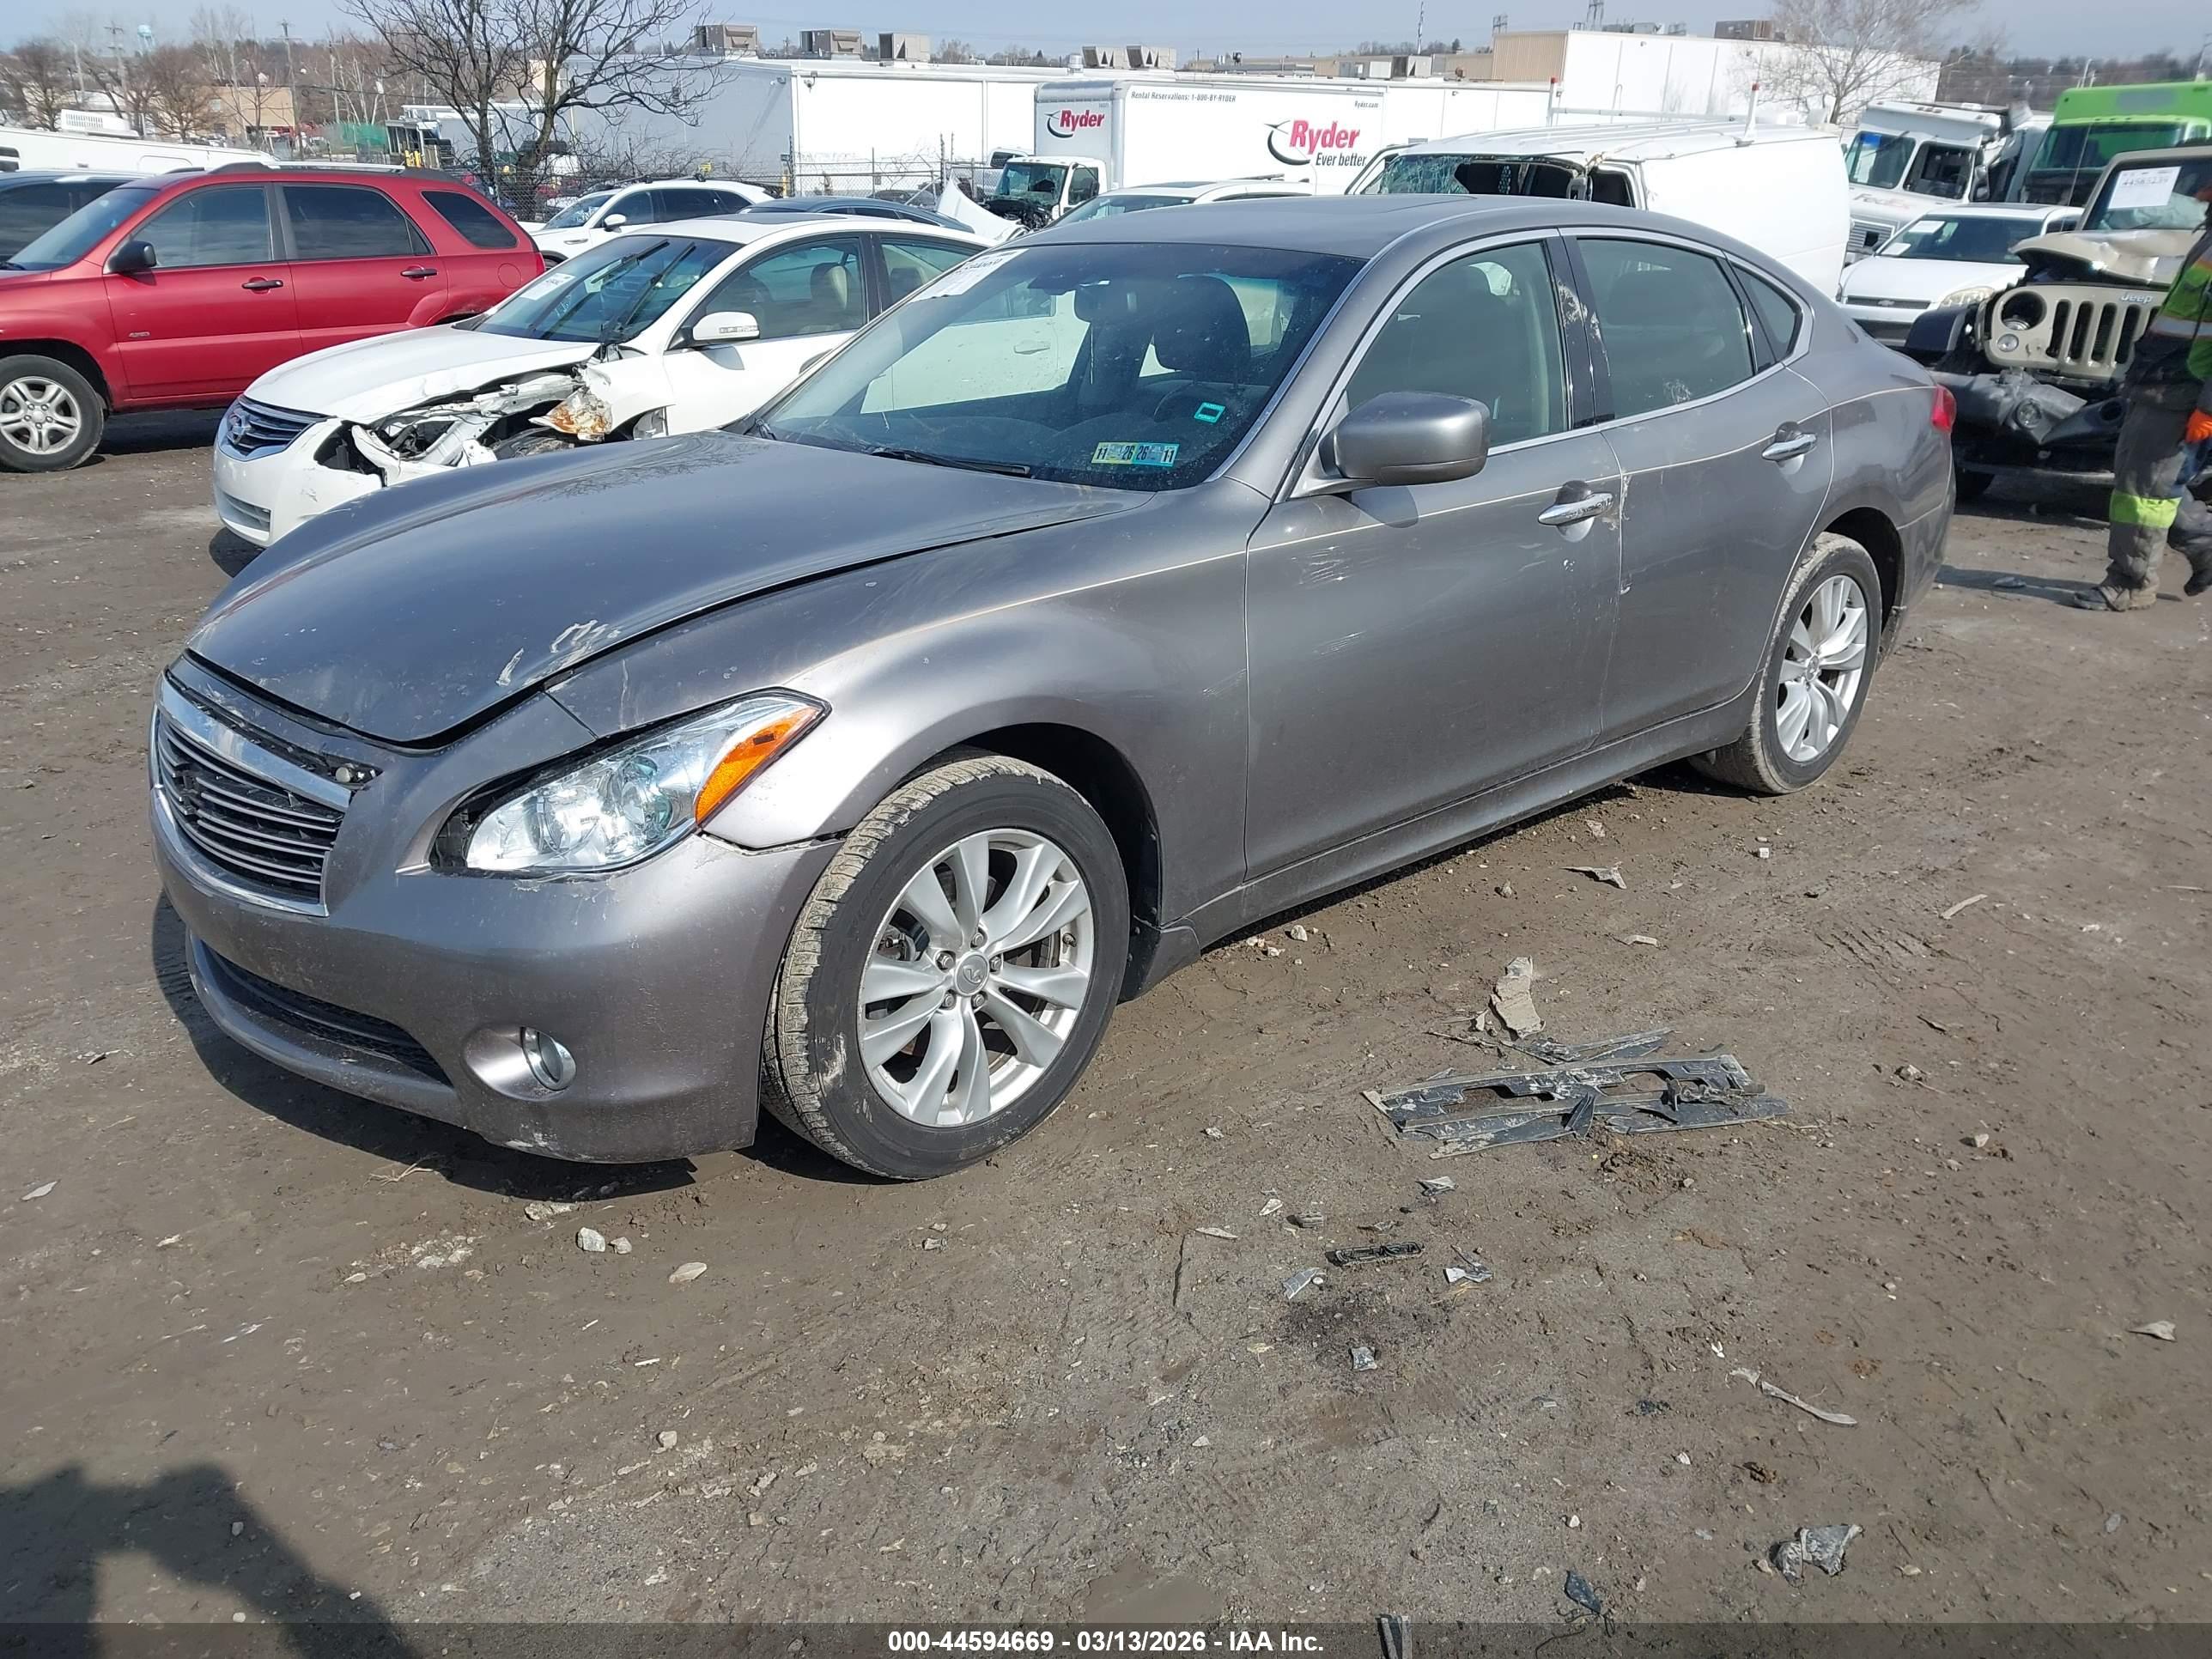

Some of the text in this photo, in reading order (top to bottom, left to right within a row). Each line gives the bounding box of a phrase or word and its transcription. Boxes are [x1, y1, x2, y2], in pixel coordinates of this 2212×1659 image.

[1131, 91, 1150, 100] Rental
[1151, 92, 1190, 101] Reservations:
[1060, 109, 1105, 131] Ryder
[1289, 120, 1361, 155] Ryder
[1316, 152, 1337, 167] Ever
[2120, 292, 2154, 304] Jeep
[1097, 445, 1175, 463] 11 26 26 11
